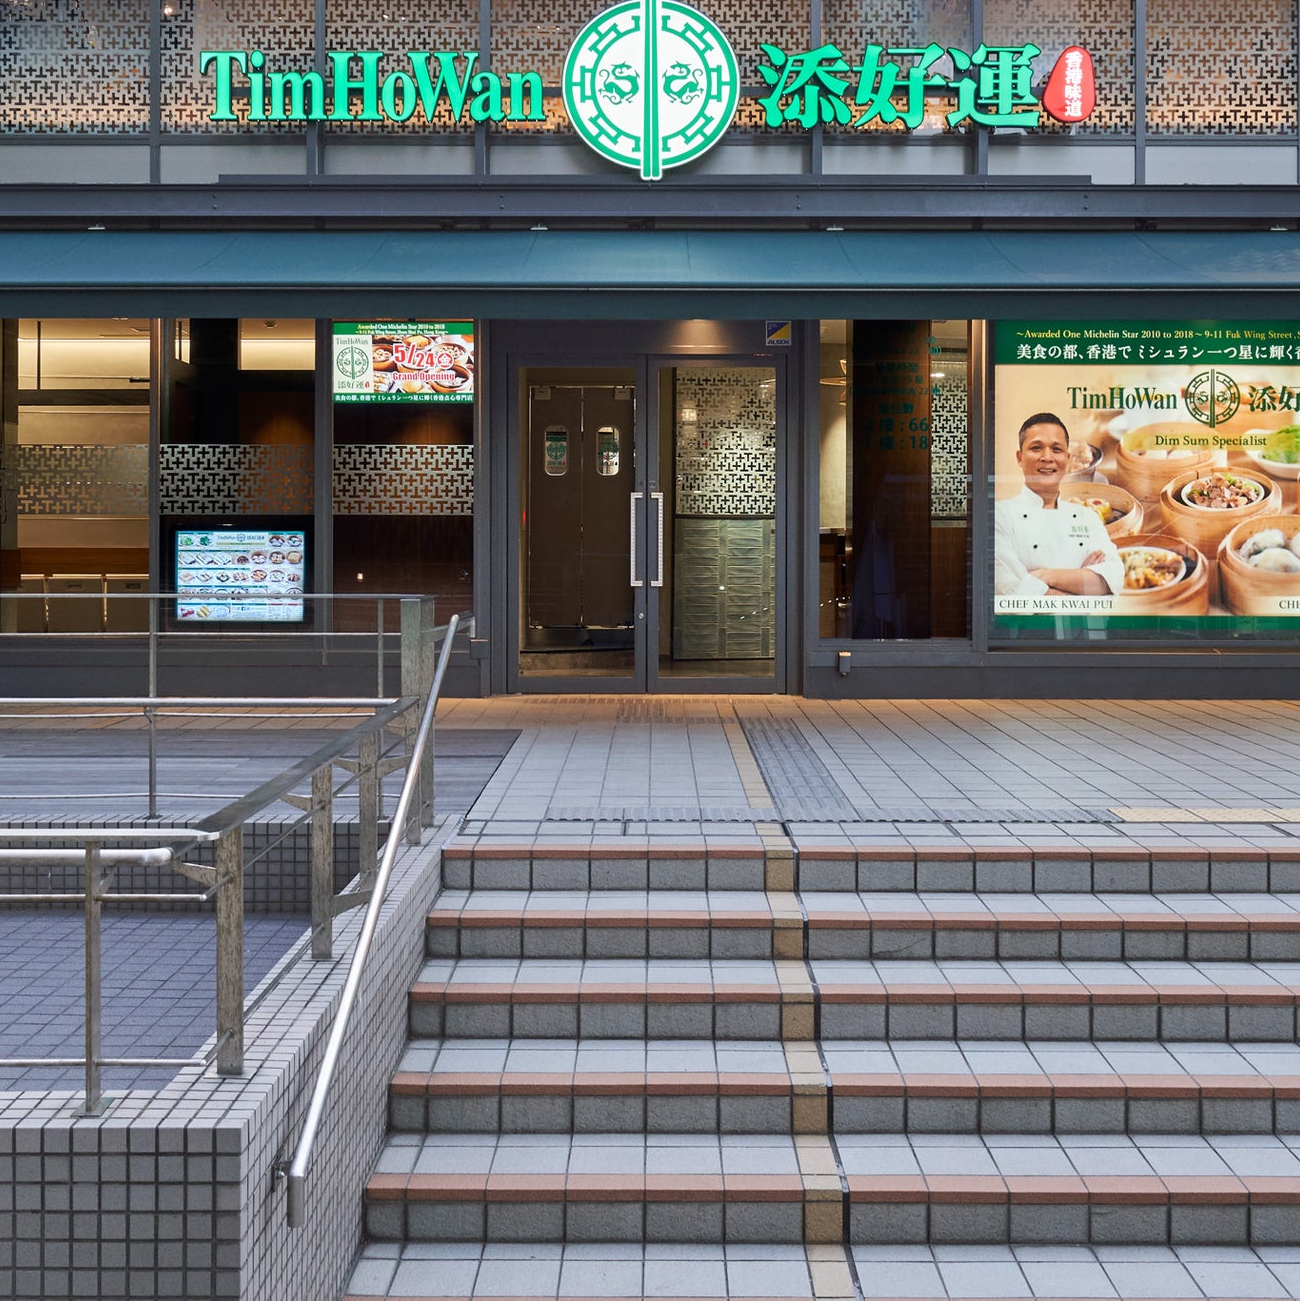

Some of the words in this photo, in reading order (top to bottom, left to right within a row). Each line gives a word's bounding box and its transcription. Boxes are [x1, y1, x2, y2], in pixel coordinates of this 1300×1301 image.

[757, 43, 1042, 129] 添好運
[1083, 330, 1119, 339] Michelin
[1121, 330, 1139, 339] Star
[1141, 330, 1161, 339] 2010
[1163, 330, 1172, 339] to
[1204, 330, 1223, 339] 9-11
[1225, 330, 1241, 339] Fuk
[1243, 330, 1266, 341] Wing
[394, 344, 435, 367] 5/24
[392, 372, 418, 381] Grand
[420, 372, 455, 381] Opening
[908, 417, 929, 432] 66
[910, 435, 929, 449] 18
[1155, 435, 1180, 446] Dim
[1182, 435, 1210, 446] Sum
[1212, 435, 1267, 448] Specialist
[999, 599, 1029, 609] CHEF
[1032, 599, 1058, 609] MAK
[1061, 599, 1090, 609] KWAI
[1094, 599, 1113, 609] PUI
